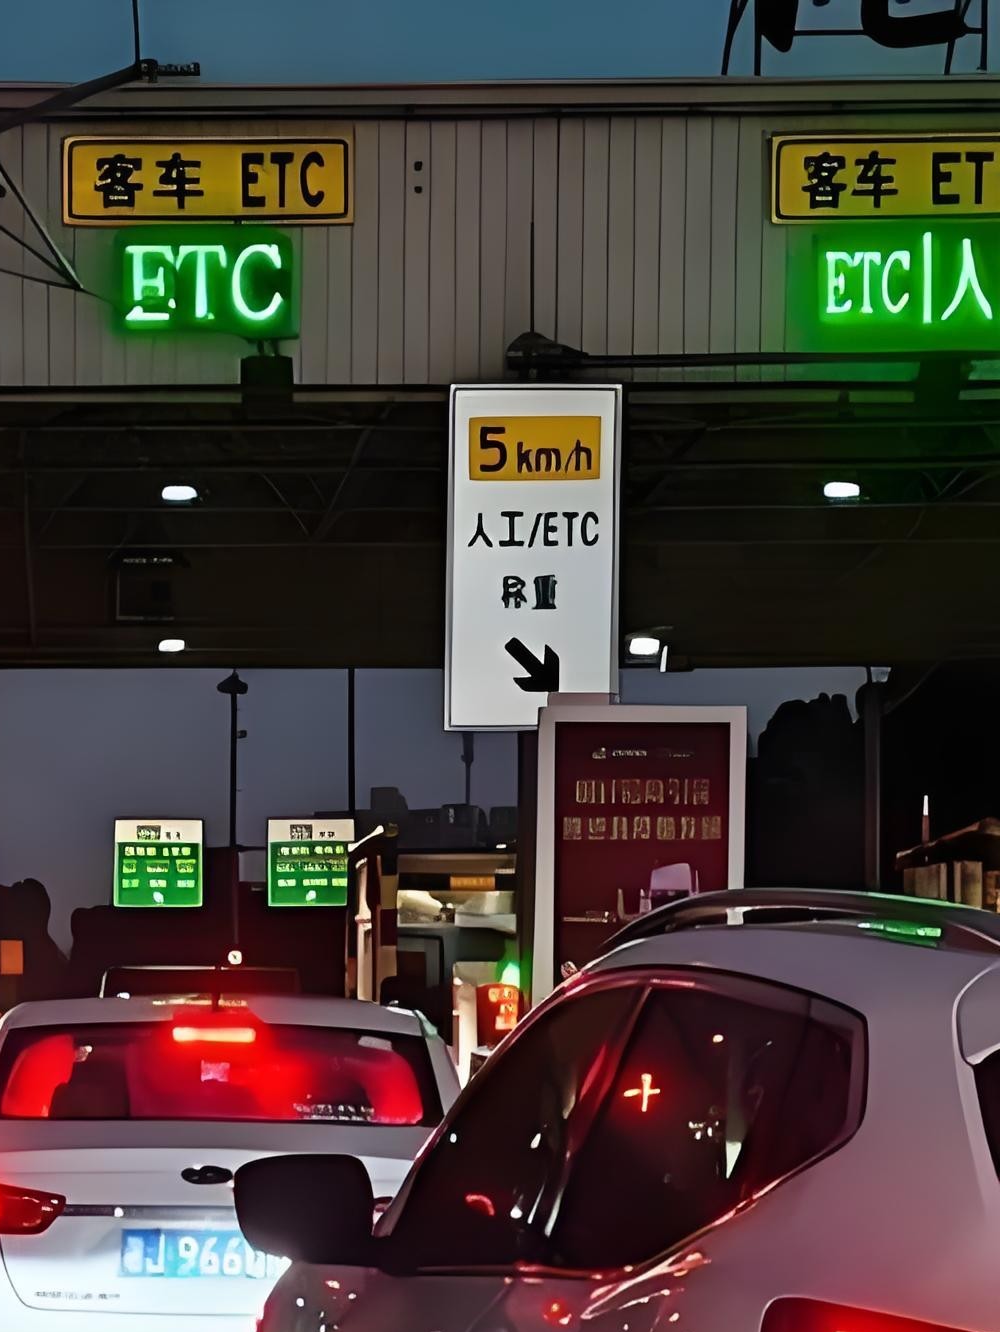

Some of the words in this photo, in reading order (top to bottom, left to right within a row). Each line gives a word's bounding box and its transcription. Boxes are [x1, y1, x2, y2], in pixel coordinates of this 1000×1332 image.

[94, 152, 204, 209] 客车
[241, 151, 325, 207] ETC
[801, 151, 898, 209] 客车
[125, 243, 283, 321] ETC
[468, 511, 600, 549] 人工/ETC
